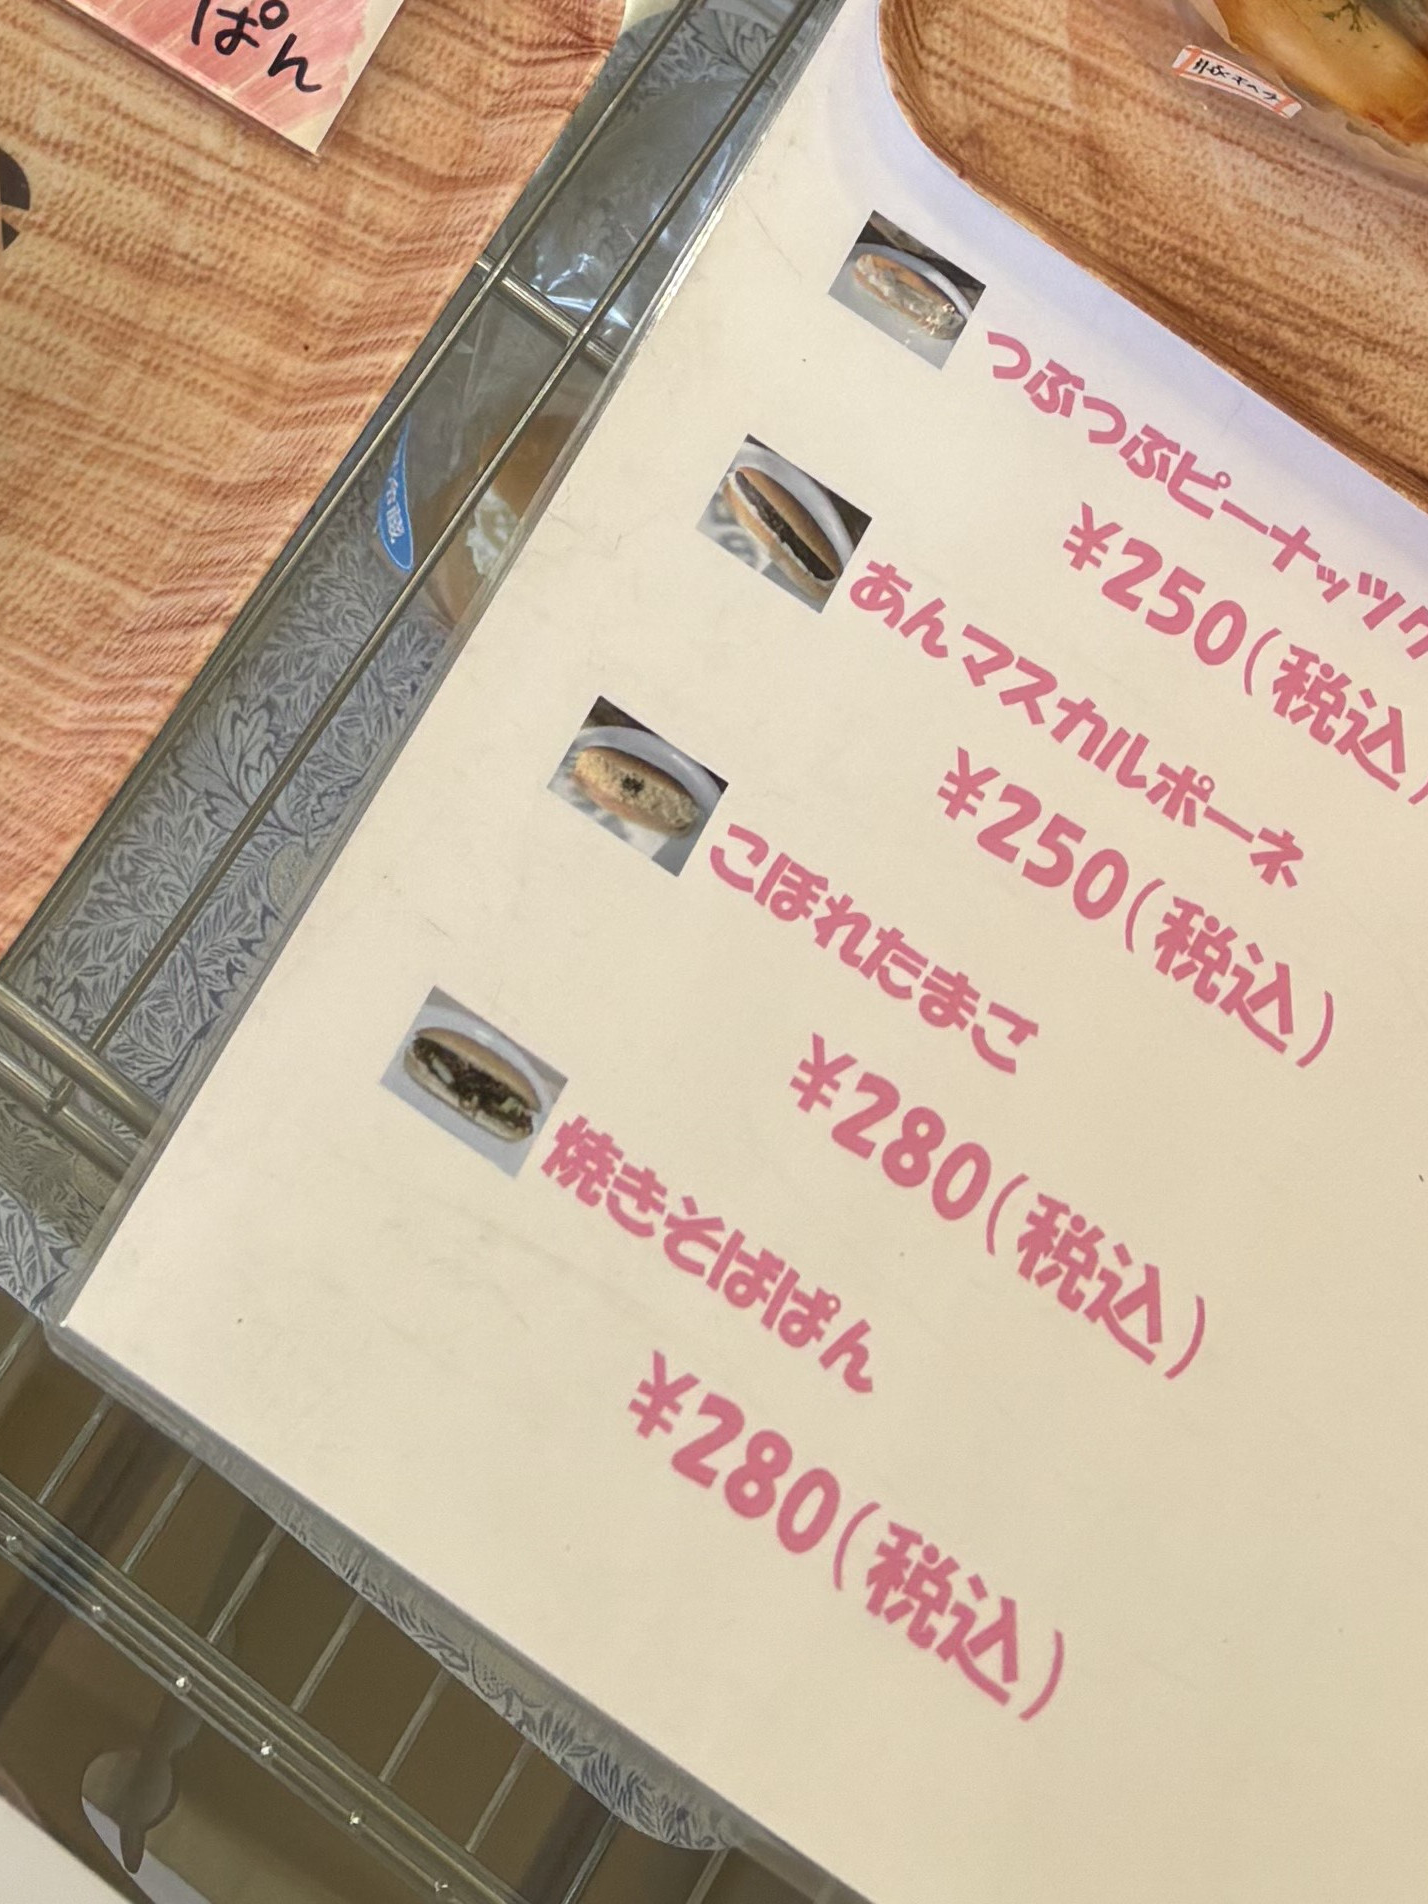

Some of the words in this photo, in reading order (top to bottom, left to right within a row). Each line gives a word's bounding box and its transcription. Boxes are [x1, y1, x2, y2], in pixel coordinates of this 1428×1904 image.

[847, 560, 1306, 890] あんマスカルポーネ
[540, 1115, 874, 1395] 焼きそばぱん
